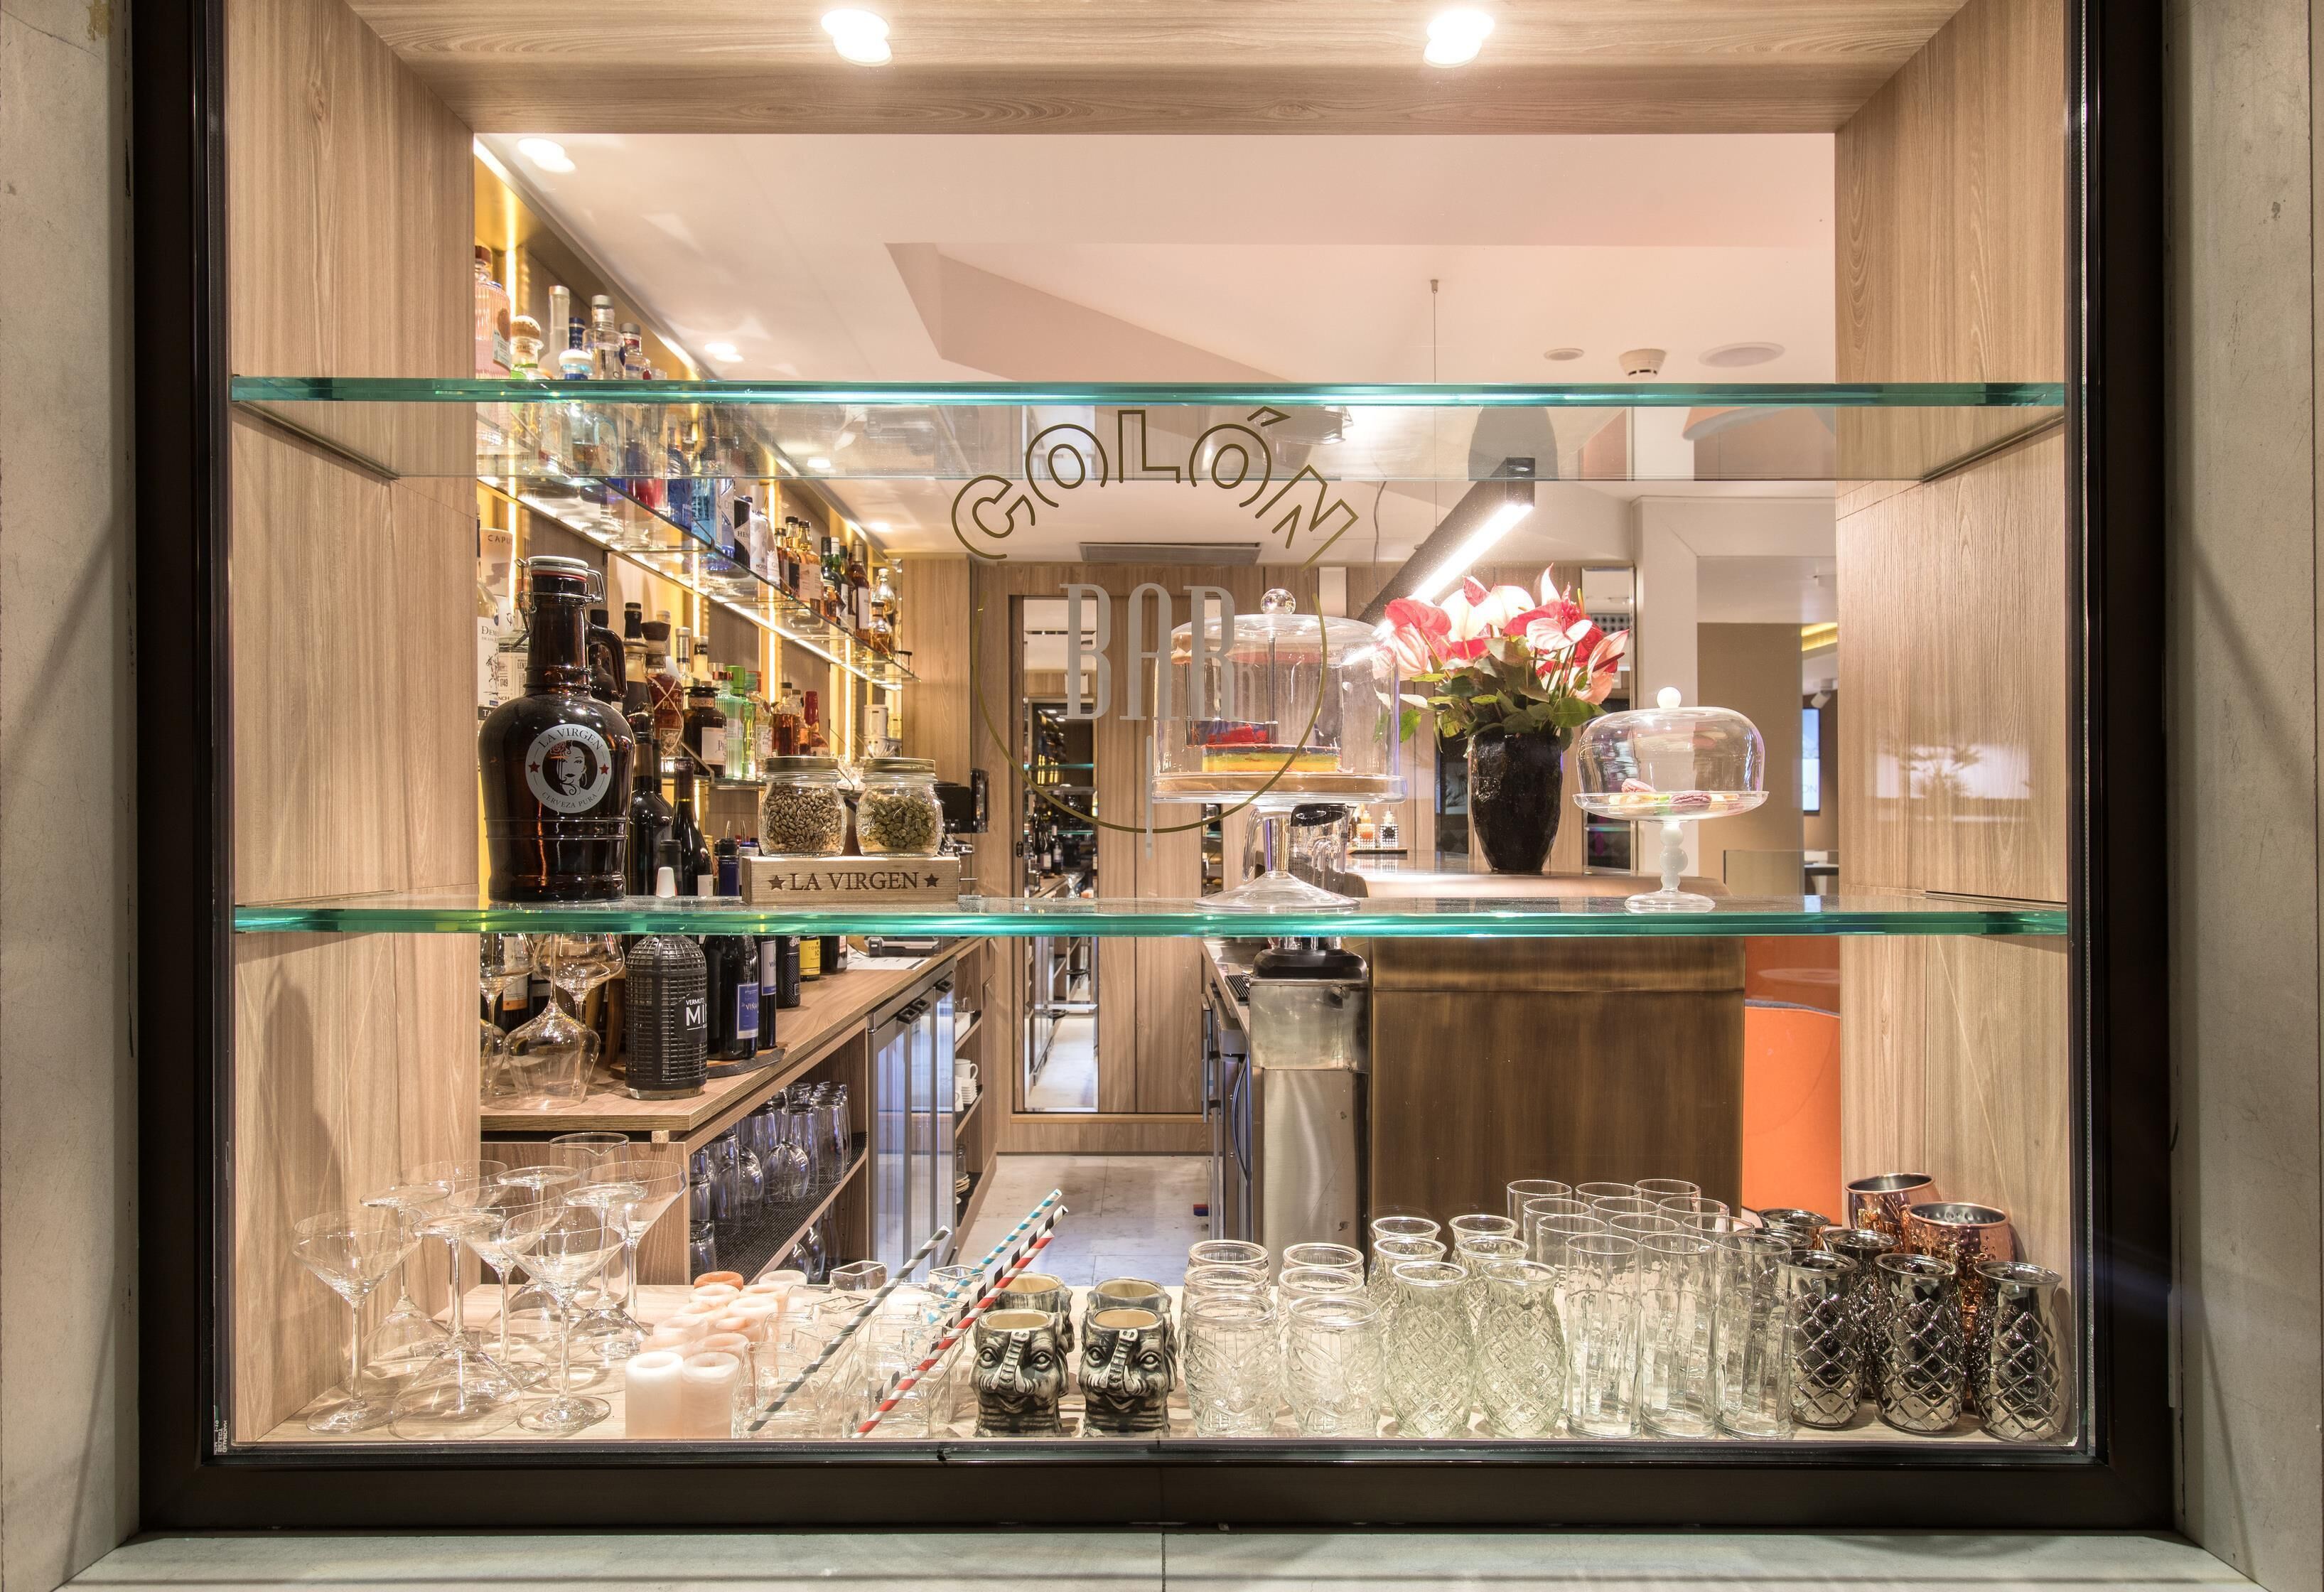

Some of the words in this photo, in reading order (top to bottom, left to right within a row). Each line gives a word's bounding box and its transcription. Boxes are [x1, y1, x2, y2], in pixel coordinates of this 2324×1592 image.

[1059, 583, 1244, 721] BAR
[539, 734, 556, 748] LA
[557, 727, 603, 751] VIRGEN
[542, 792, 576, 808] CERVEZA
[579, 794, 597, 807] PURA
[790, 873, 822, 891] LA
[827, 871, 919, 890] VIRGEN
